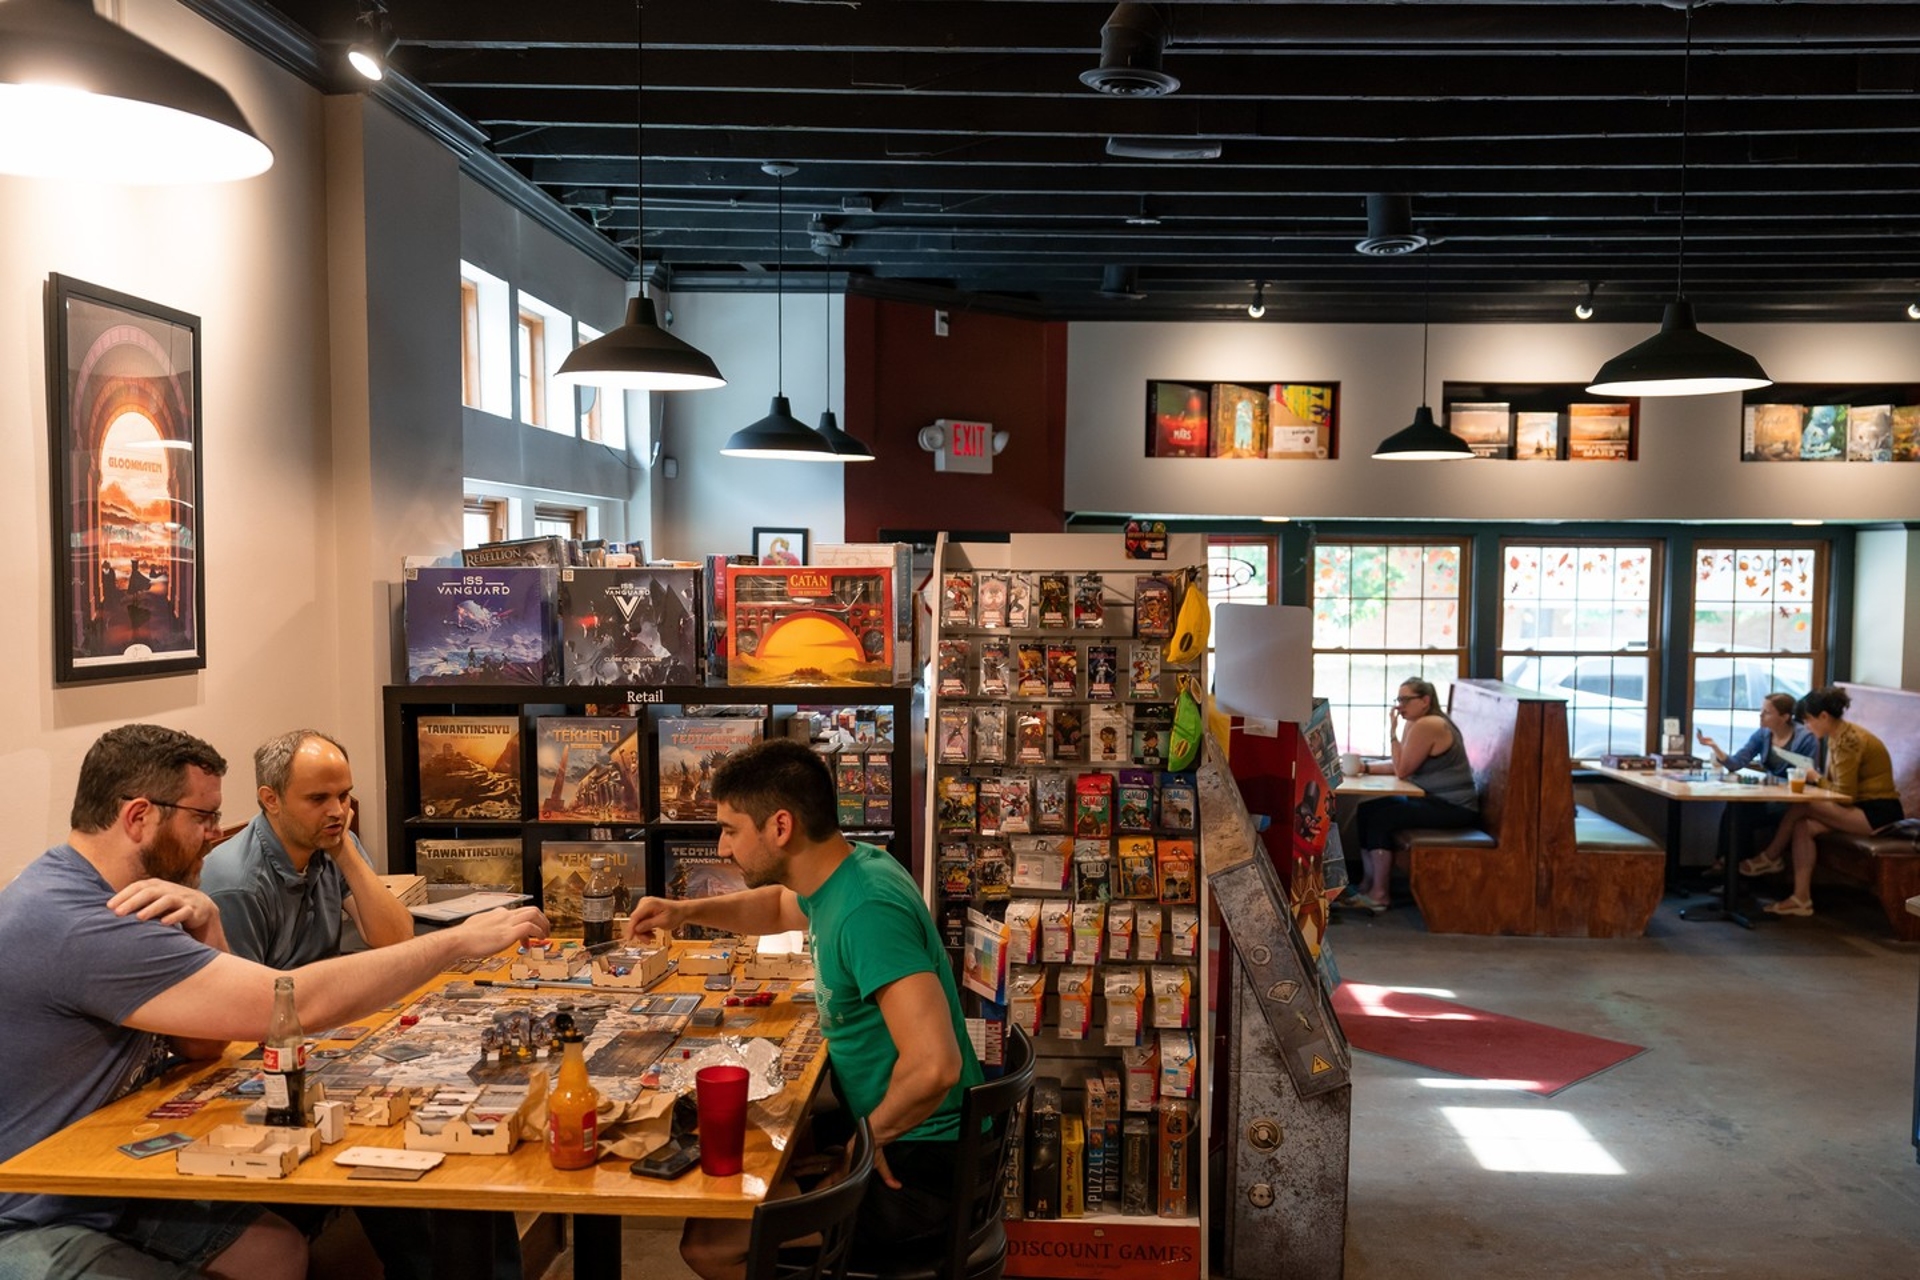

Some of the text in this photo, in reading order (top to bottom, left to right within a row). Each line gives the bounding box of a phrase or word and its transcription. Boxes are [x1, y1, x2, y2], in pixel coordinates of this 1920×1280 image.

[952, 423, 985, 458] EXIT
[1173, 428, 1192, 440] MARS
[108, 457, 162, 473] GLOOMHAVEN
[465, 547, 521, 567] REBELLION
[463, 576, 484, 585] ISS
[790, 574, 828, 587] CATAN
[437, 586, 511, 595] VANGUARD
[627, 689, 664, 703] Retail
[426, 724, 510, 734] TAWANTINSUYU
[552, 729, 621, 743] TEKHENU
[426, 847, 514, 858] TAWANTINSUYU
[671, 847, 717, 856] TEOTIH
[986, 1021, 1002, 1065] MARVEL
[1105, 1142, 1119, 1192] PUZZLE
[1088, 1150, 1104, 1202] PUZZLE
[1007, 1240, 1192, 1262] DISCOUNT GAMES
